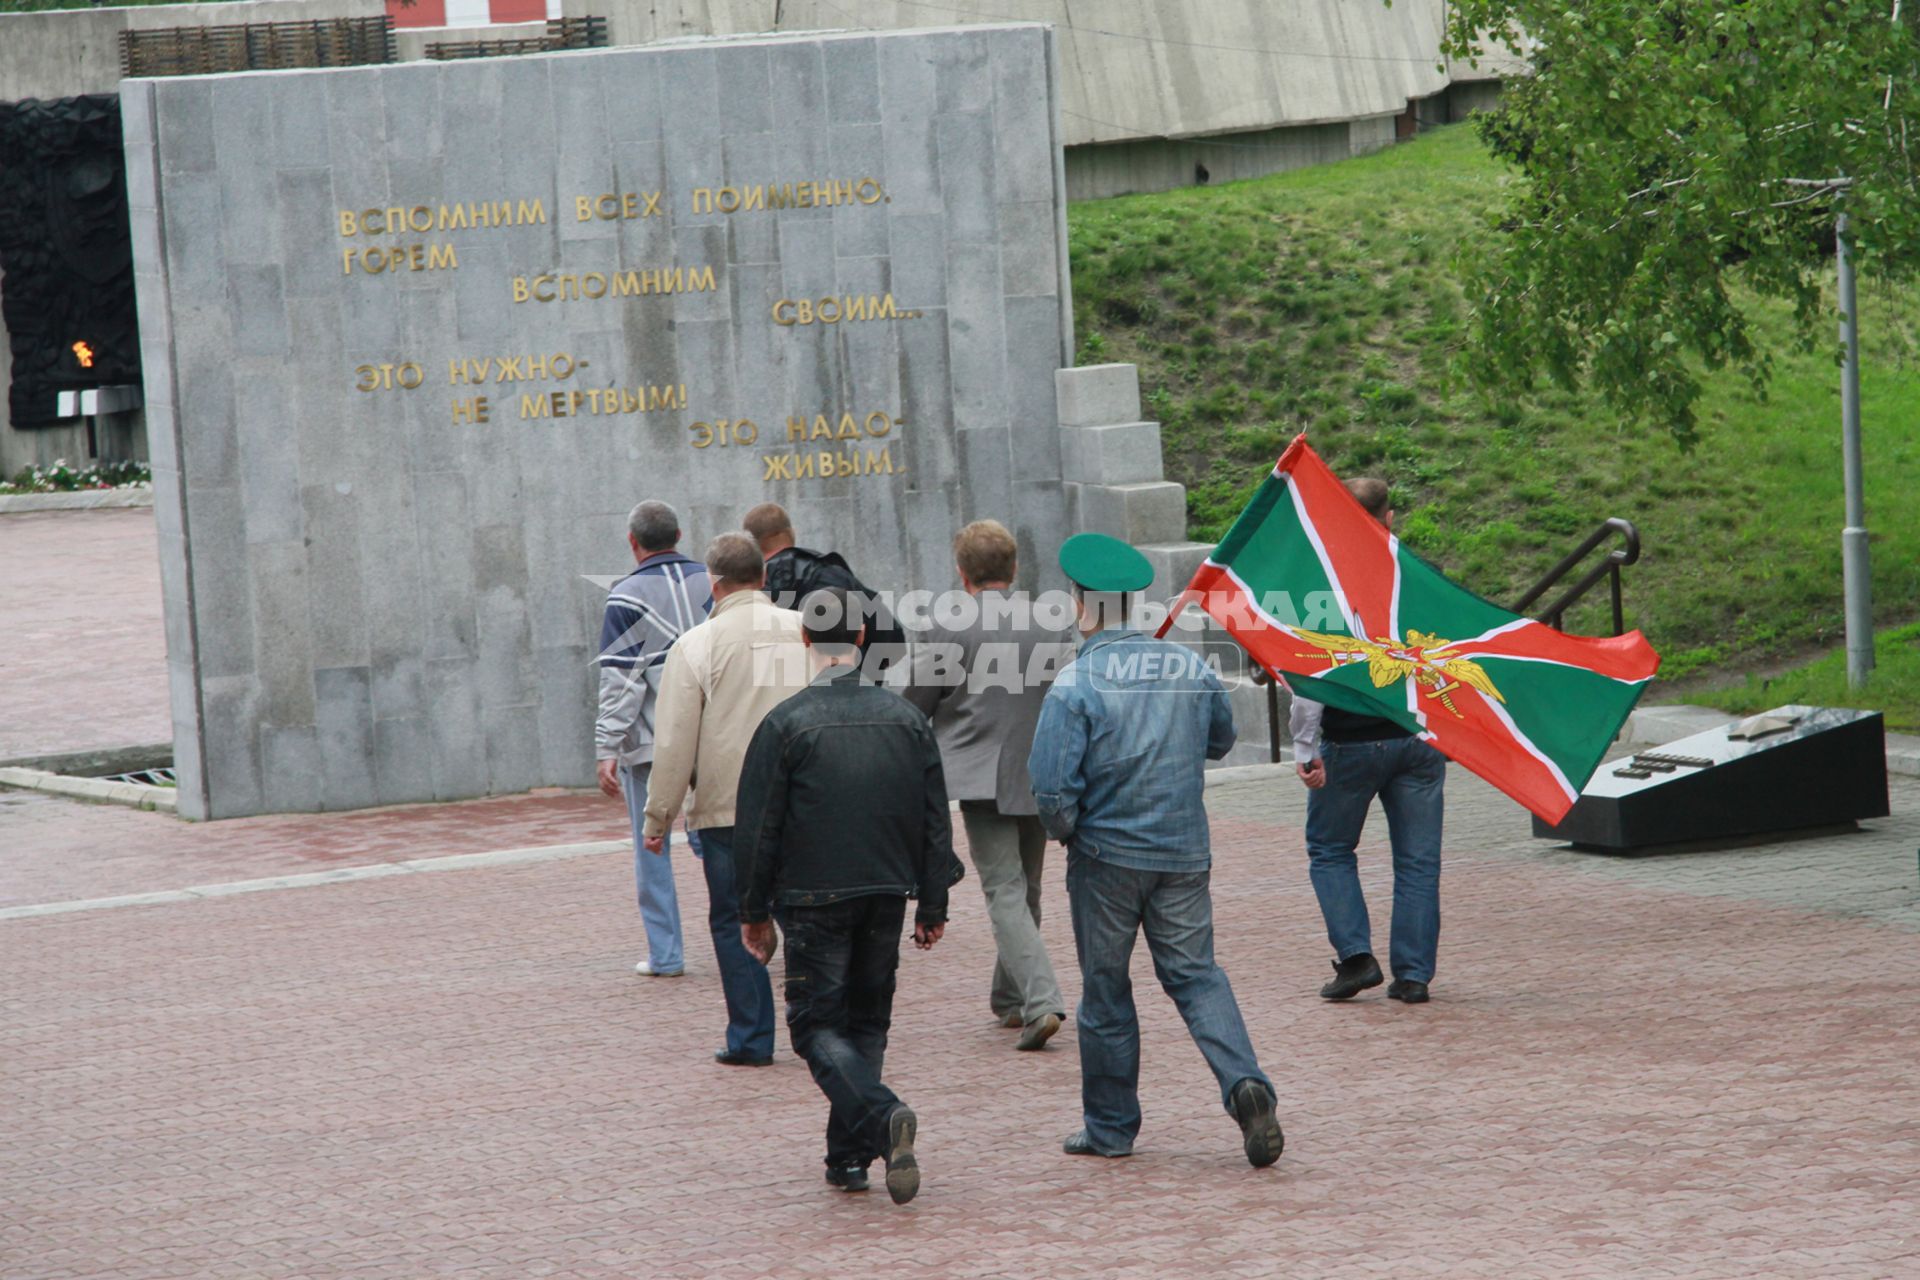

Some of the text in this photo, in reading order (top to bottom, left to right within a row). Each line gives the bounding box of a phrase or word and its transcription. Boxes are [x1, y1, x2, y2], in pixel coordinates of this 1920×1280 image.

[339, 177, 891, 236] ВСПОМНИМ ВСЕХ ПОИМЕННО.
[343, 243, 458, 275] ГОРЕМ
[513, 265, 716, 303] ВСПОМНИМ
[772, 293, 923, 326] СВОИМ...
[355, 361, 424, 392] ЭТО
[453, 384, 687, 424] НЕ МЕРТВЫМ!
[689, 419, 758, 448] ЭТО
